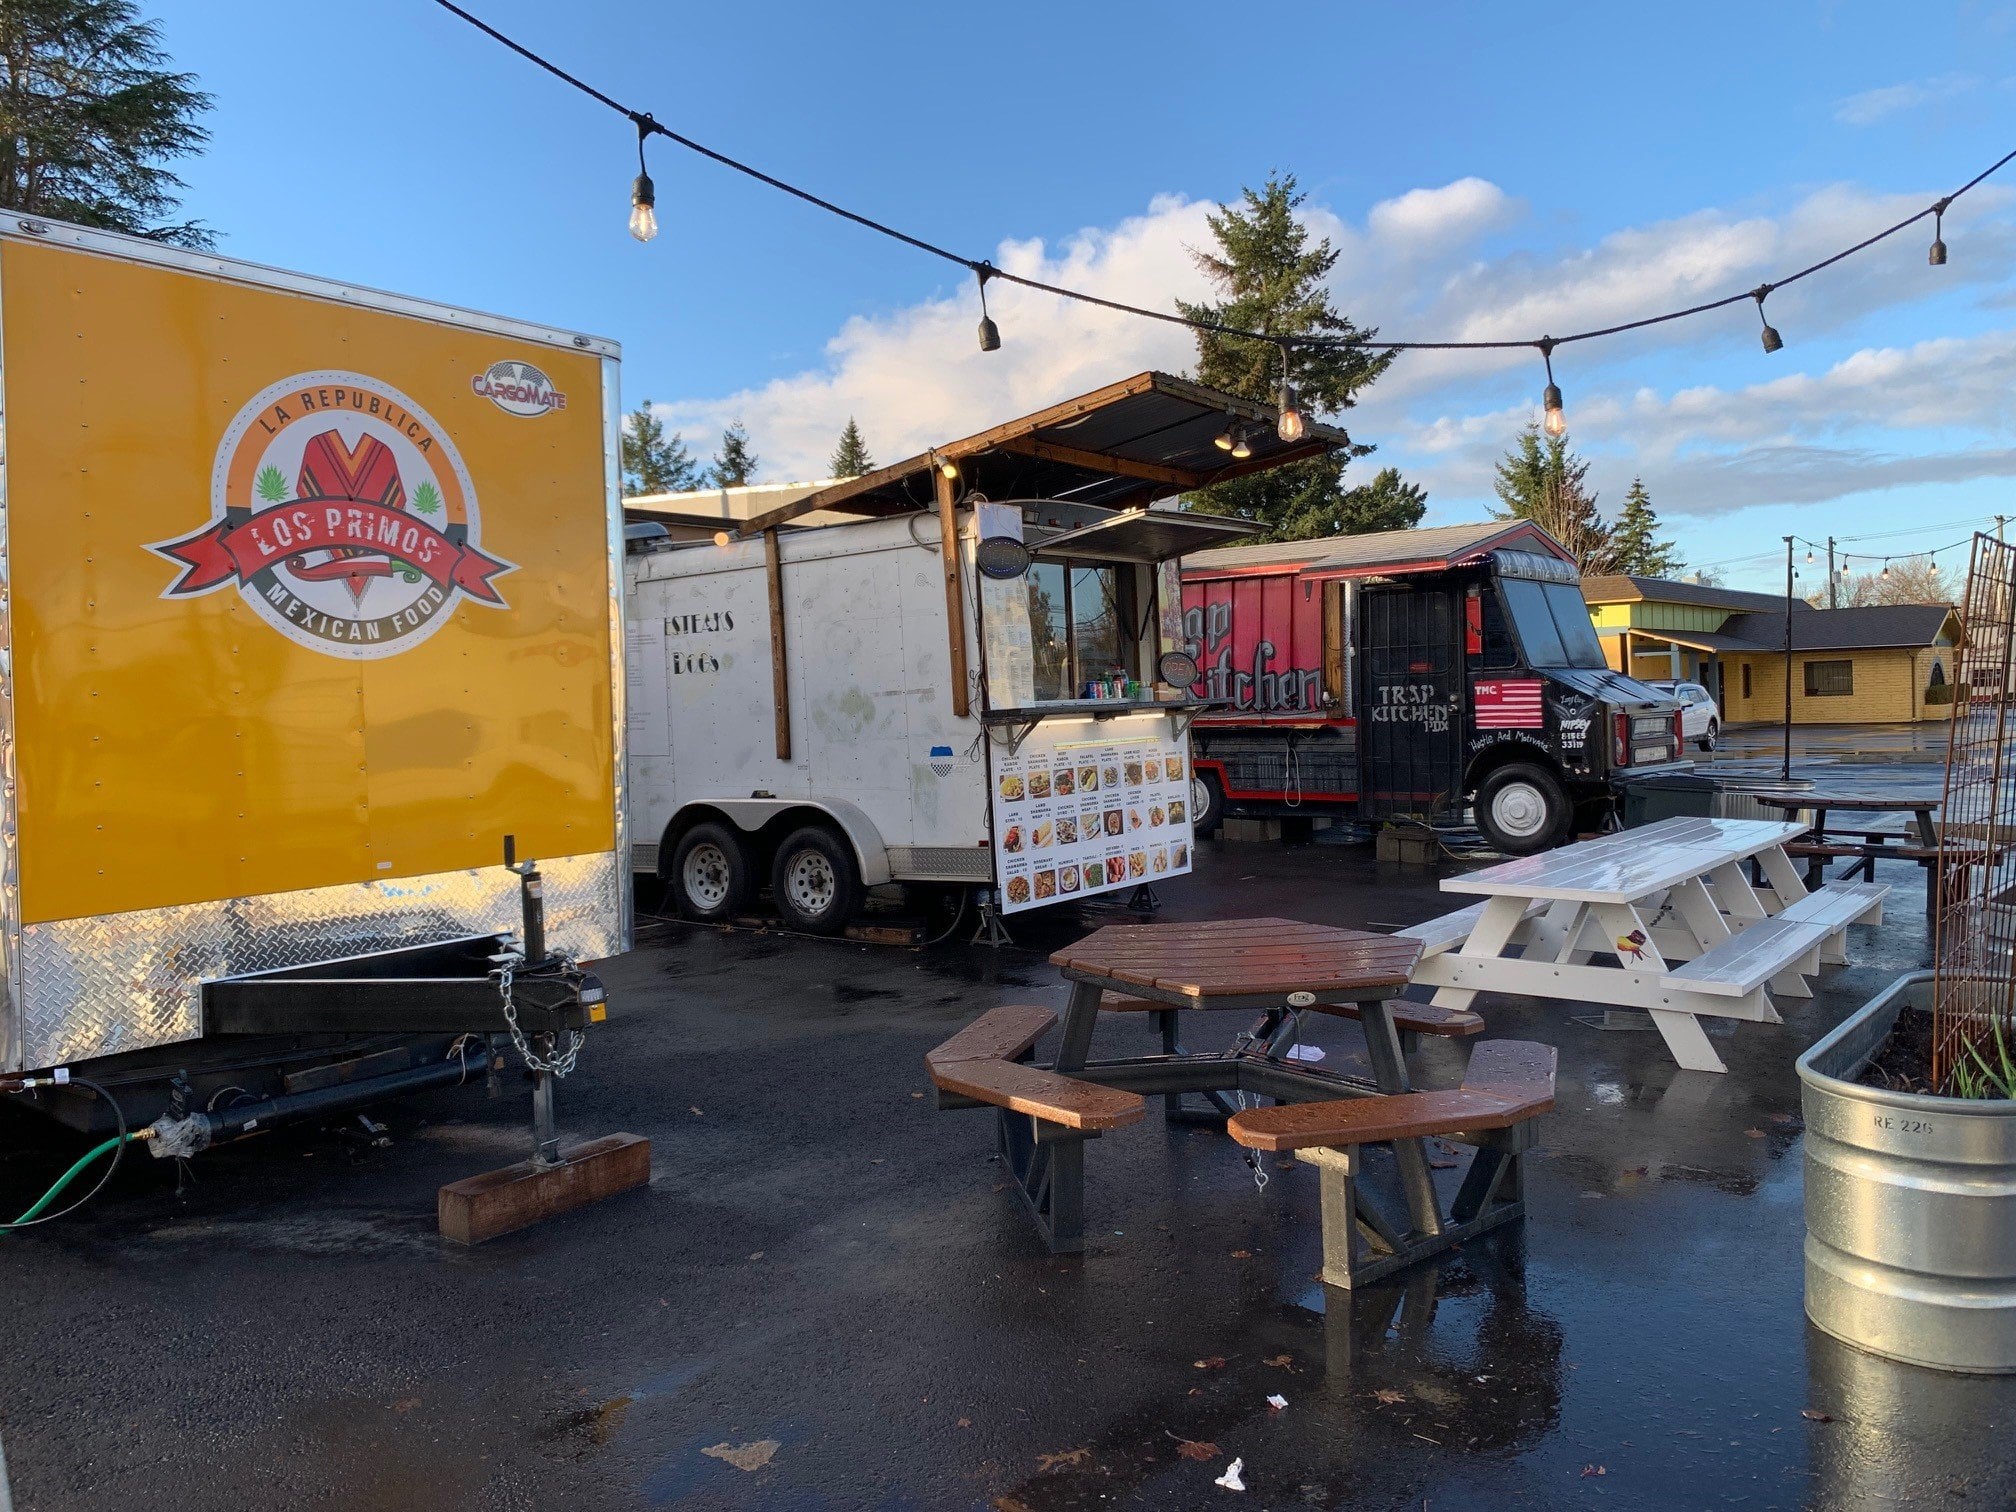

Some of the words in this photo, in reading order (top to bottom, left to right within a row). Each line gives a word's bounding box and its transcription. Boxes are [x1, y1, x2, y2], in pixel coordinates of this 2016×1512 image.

[472, 375, 566, 410] CARGOMATE
[259, 405, 291, 435] LA
[301, 389, 435, 453] REPUBLICA
[250, 511, 315, 556] LOS
[266, 583, 380, 641] MEXICAN
[392, 586, 444, 634] FOOD
[1184, 602, 1232, 652] ap
[1164, 661, 1194, 677] OPEN
[1378, 684, 1435, 705] TRAP
[1475, 685, 1498, 695] TMC
[1371, 704, 1448, 722] KITCHEN
[1423, 720, 1449, 733] PDX
[1498, 730, 1511, 742] And
[1873, 1115, 1894, 1130] RE
